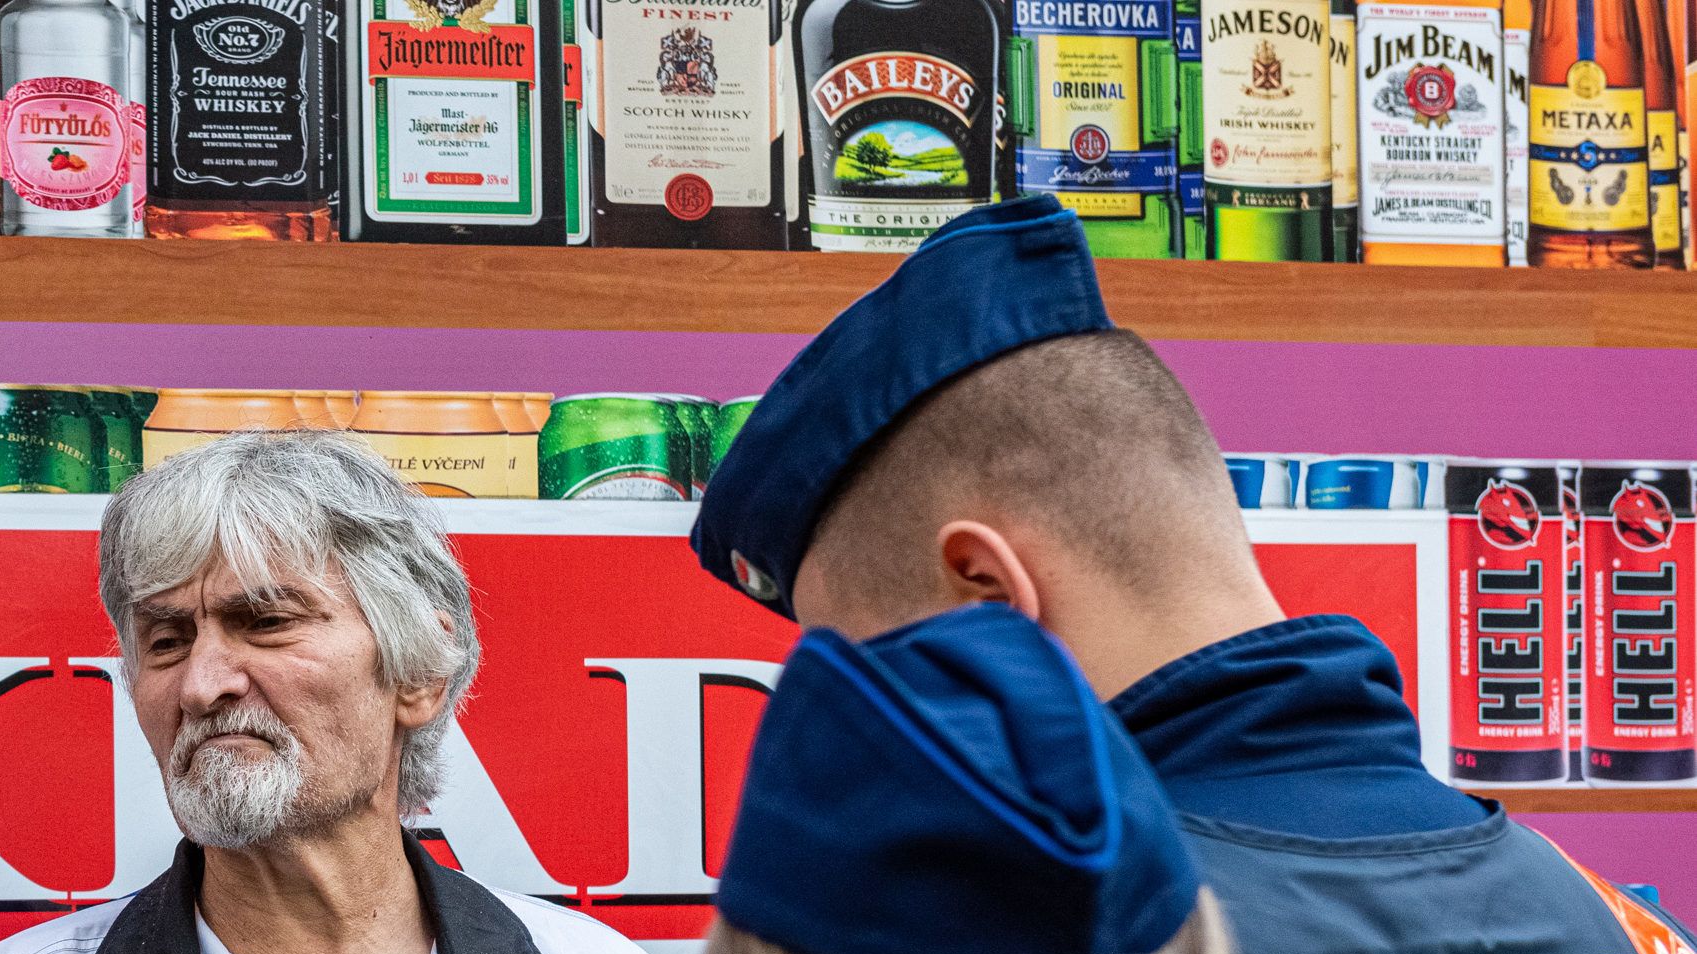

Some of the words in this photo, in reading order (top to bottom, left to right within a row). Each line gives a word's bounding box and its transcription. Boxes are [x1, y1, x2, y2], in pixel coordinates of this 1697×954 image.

[642, 8, 734, 22] FINEST
[1016, 0, 1159, 28] BECHEROVKA
[228, 25, 249, 33] Old
[1208, 10, 1323, 47] JAMESON
[218, 33, 260, 47] No.7
[1365, 34, 1415, 79] JIM
[1422, 25, 1494, 85] BEAM
[192, 67, 287, 89] Tennessee
[821, 59, 975, 111] BAILEYS
[1053, 82, 1126, 100] ORIGINAL
[194, 98, 286, 113] WHISKEY
[623, 106, 685, 118] SCOTCH
[691, 108, 752, 120] WHISKY
[20, 113, 111, 137] FÜTYÜLŐS
[408, 118, 480, 135] Jägermeister
[1220, 118, 1252, 129] IRISH
[1258, 120, 1316, 131] WHISKEY
[1541, 109, 1633, 130] METAXA
[187, 131, 210, 139] JACK
[243, 133, 292, 141] DISTILLERY
[417, 138, 490, 149] WOLFENBÜTTEL
[1380, 135, 1431, 148] KENTUCKY
[1434, 136, 1482, 149] STRAIGHT
[1386, 149, 1431, 161] BOURBON
[1435, 151, 1478, 163] WHISKEY
[1244, 198, 1297, 206] IRELAND
[1372, 197, 1402, 216] JAMES
[1435, 198, 1479, 217] DISTILLING
[829, 212, 862, 223] THE
[876, 214, 958, 225] ORIGIN
[422, 456, 484, 470] VÝČEPNÍ
[1459, 568, 1469, 614] DRINK
[1594, 570, 1605, 615] DRINK
[1459, 617, 1469, 676] ENERGY
[1478, 560, 1543, 724] HELL
[1594, 619, 1605, 677] ENERGY
[1613, 562, 1678, 726] HELL
[1479, 726, 1514, 738] ENERGY
[1613, 726, 1651, 738] ENERGY
